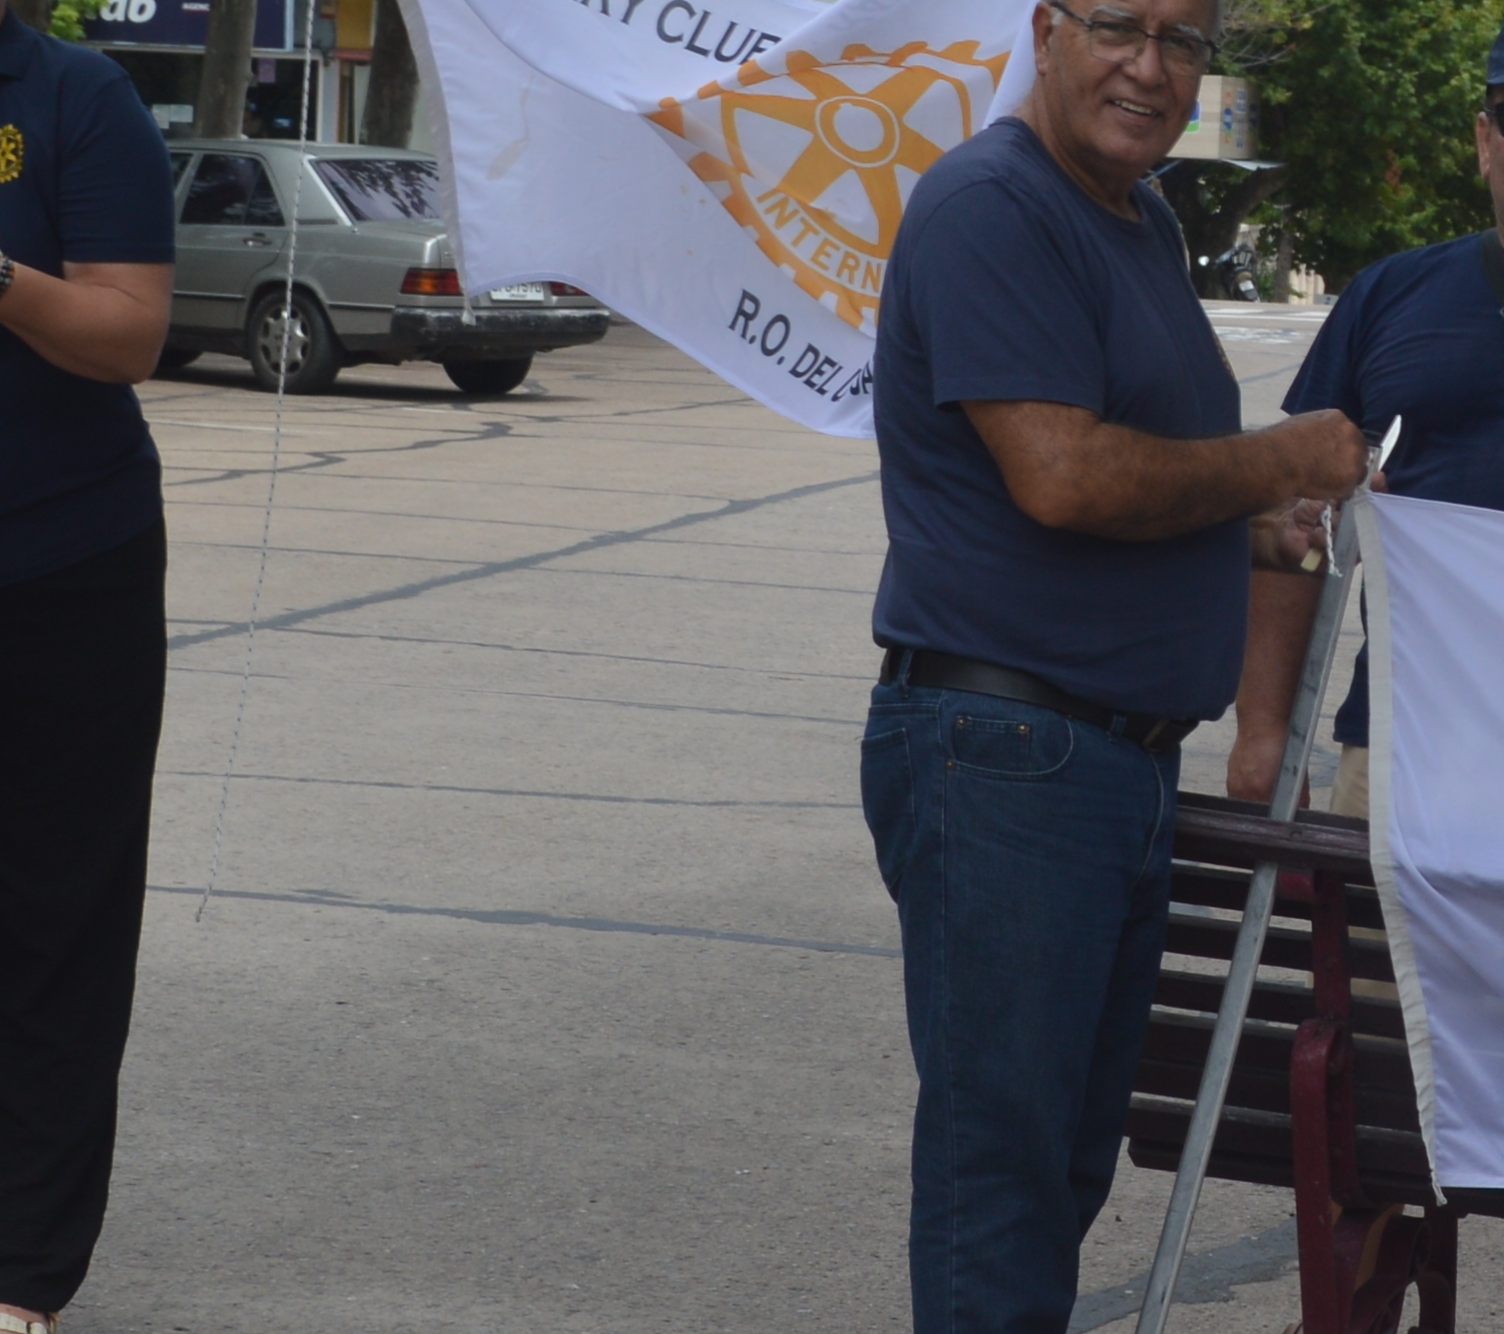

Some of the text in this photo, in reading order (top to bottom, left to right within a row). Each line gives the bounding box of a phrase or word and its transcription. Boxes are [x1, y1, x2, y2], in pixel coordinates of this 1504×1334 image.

[757, 189, 882, 293] INTERN
[728, 288, 791, 366] R.O.
[788, 343, 844, 396] DEL
